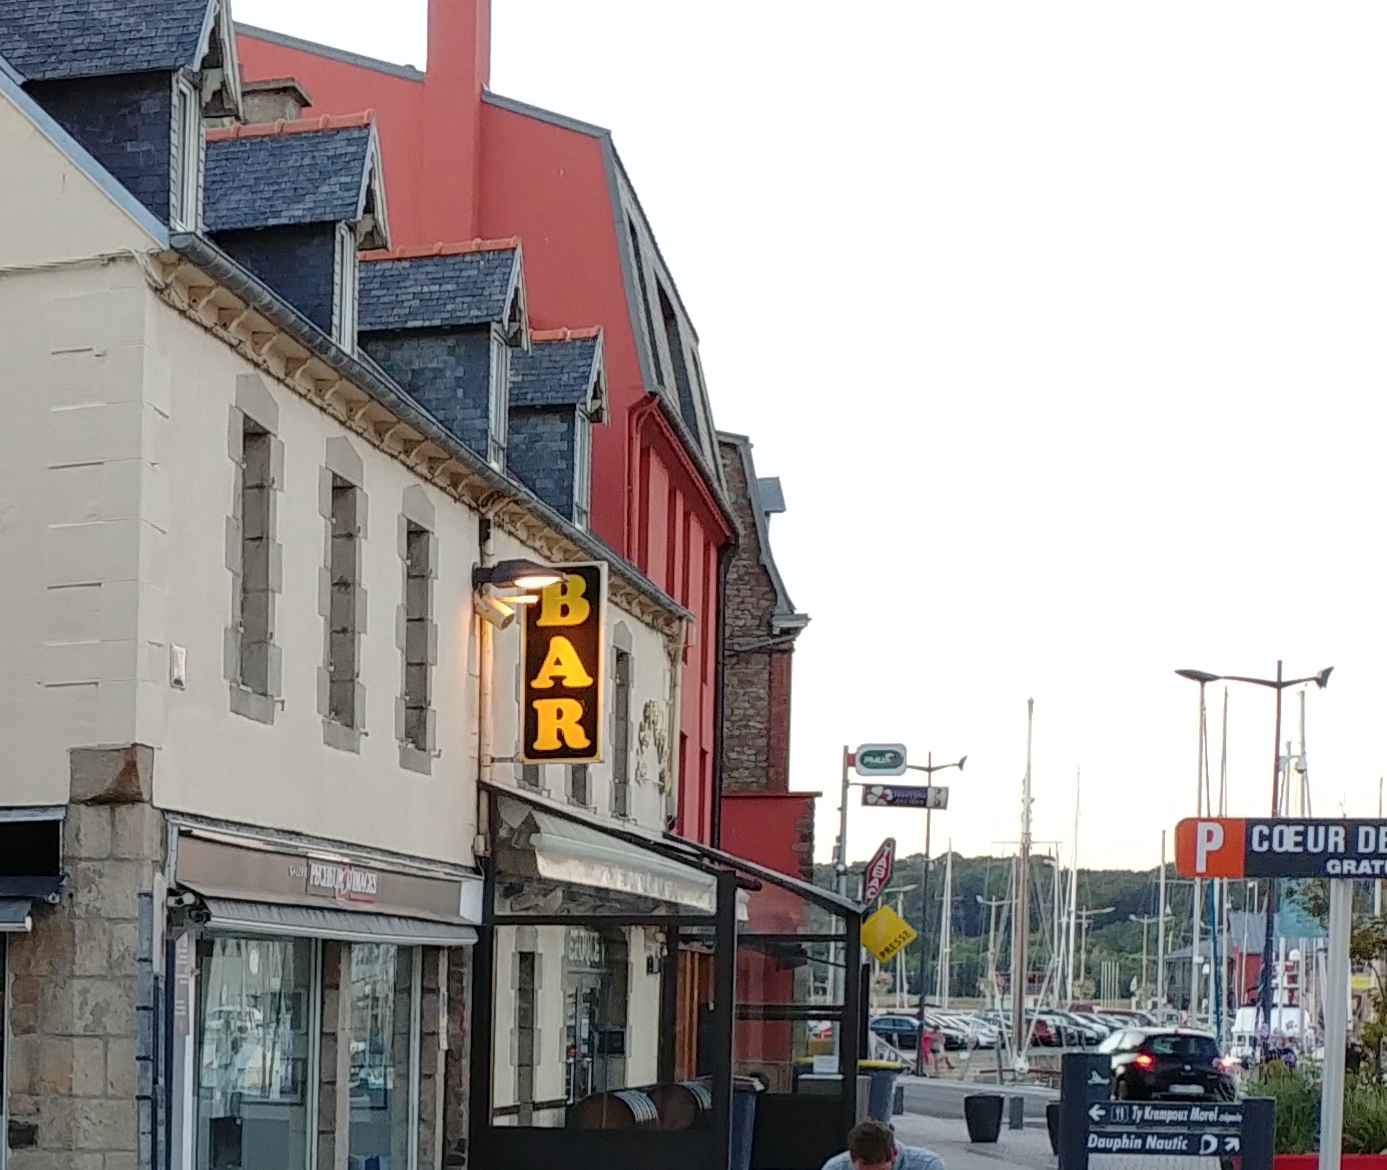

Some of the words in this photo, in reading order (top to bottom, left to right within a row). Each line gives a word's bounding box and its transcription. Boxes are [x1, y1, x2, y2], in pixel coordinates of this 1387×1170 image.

[530, 573, 594, 751] BAR
[1195, 821, 1225, 873] P
[1251, 825, 1346, 854] CŒUR
[867, 841, 893, 899] TABAC
[1326, 859, 1387, 875] GRAT
[879, 929, 912, 960] PRESSE
[1131, 1105, 1143, 1124] Ty
[1189, 1106, 1219, 1122] Morel
[1087, 1133, 1142, 1151] Dauphin
[1145, 1134, 1189, 1151] Nautic
